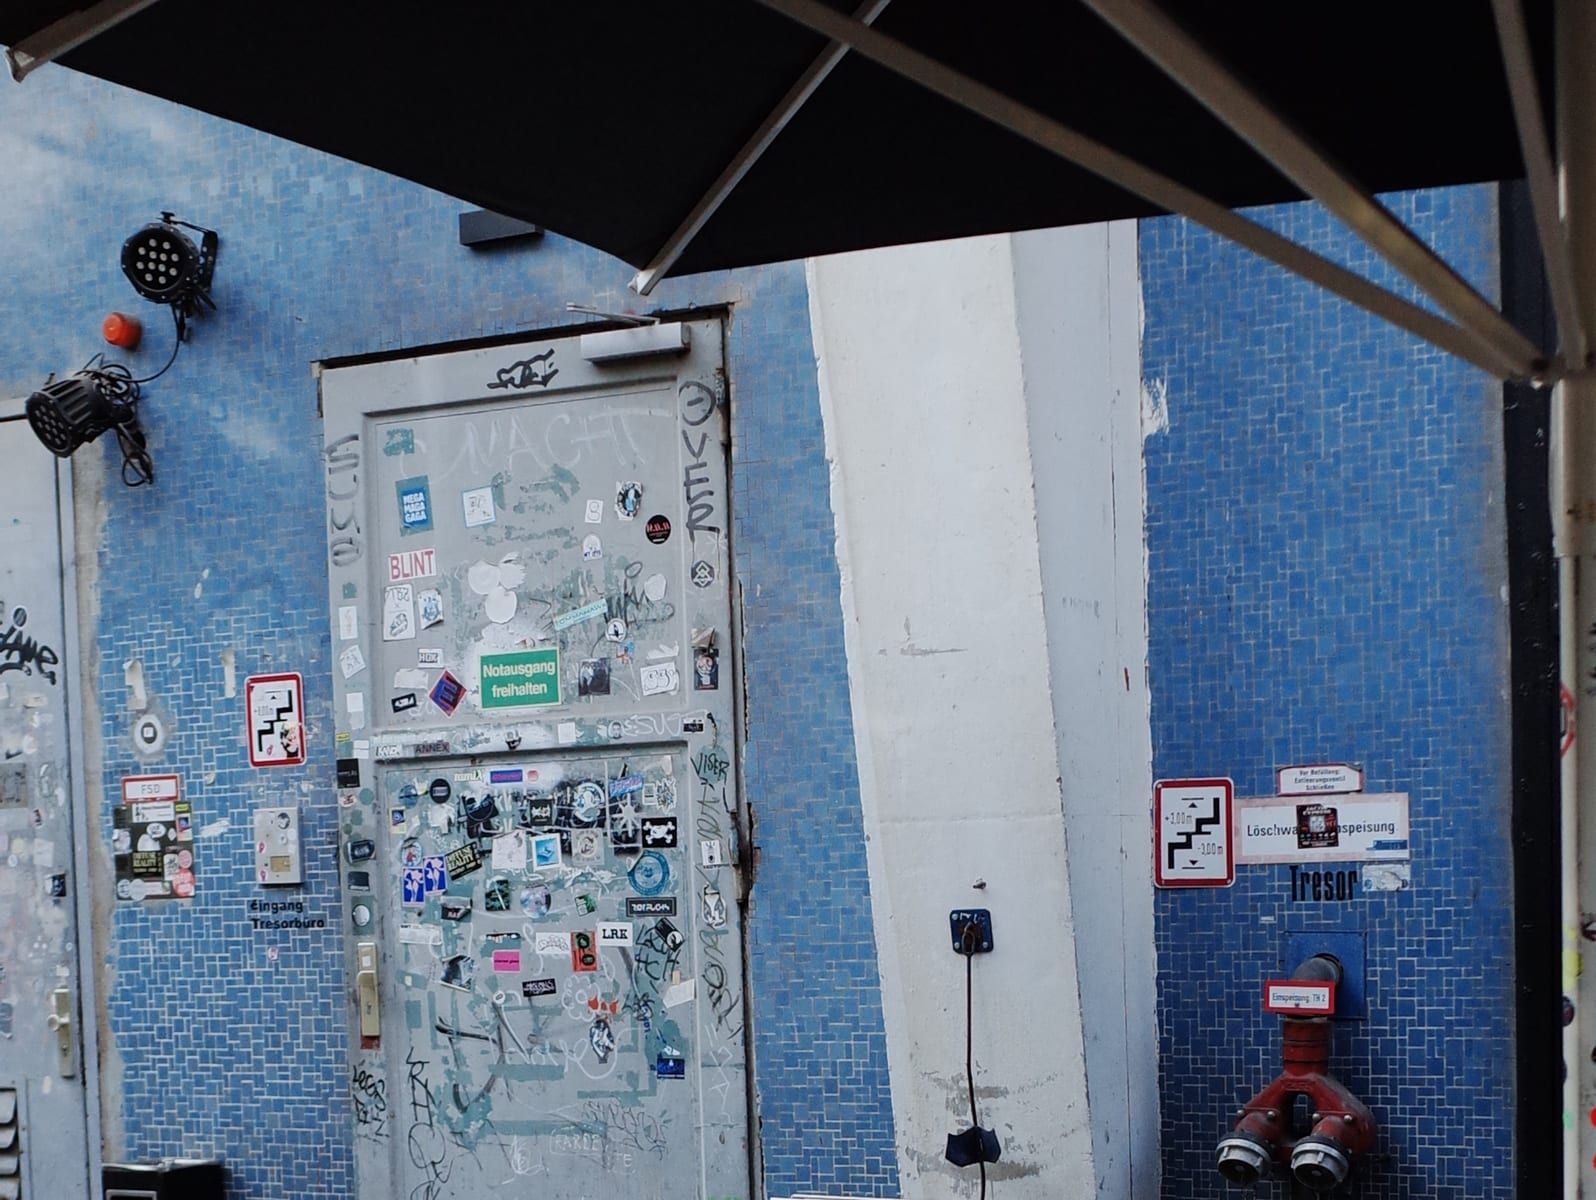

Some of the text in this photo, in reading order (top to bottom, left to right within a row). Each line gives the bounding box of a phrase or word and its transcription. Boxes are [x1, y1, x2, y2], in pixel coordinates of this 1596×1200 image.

[389, 550, 434, 580] BLINT
[483, 661, 556, 679] Notausgang
[491, 681, 548, 698] freihalten
[1289, 865, 1358, 901] Tresor
[602, 929, 629, 940] LRK
